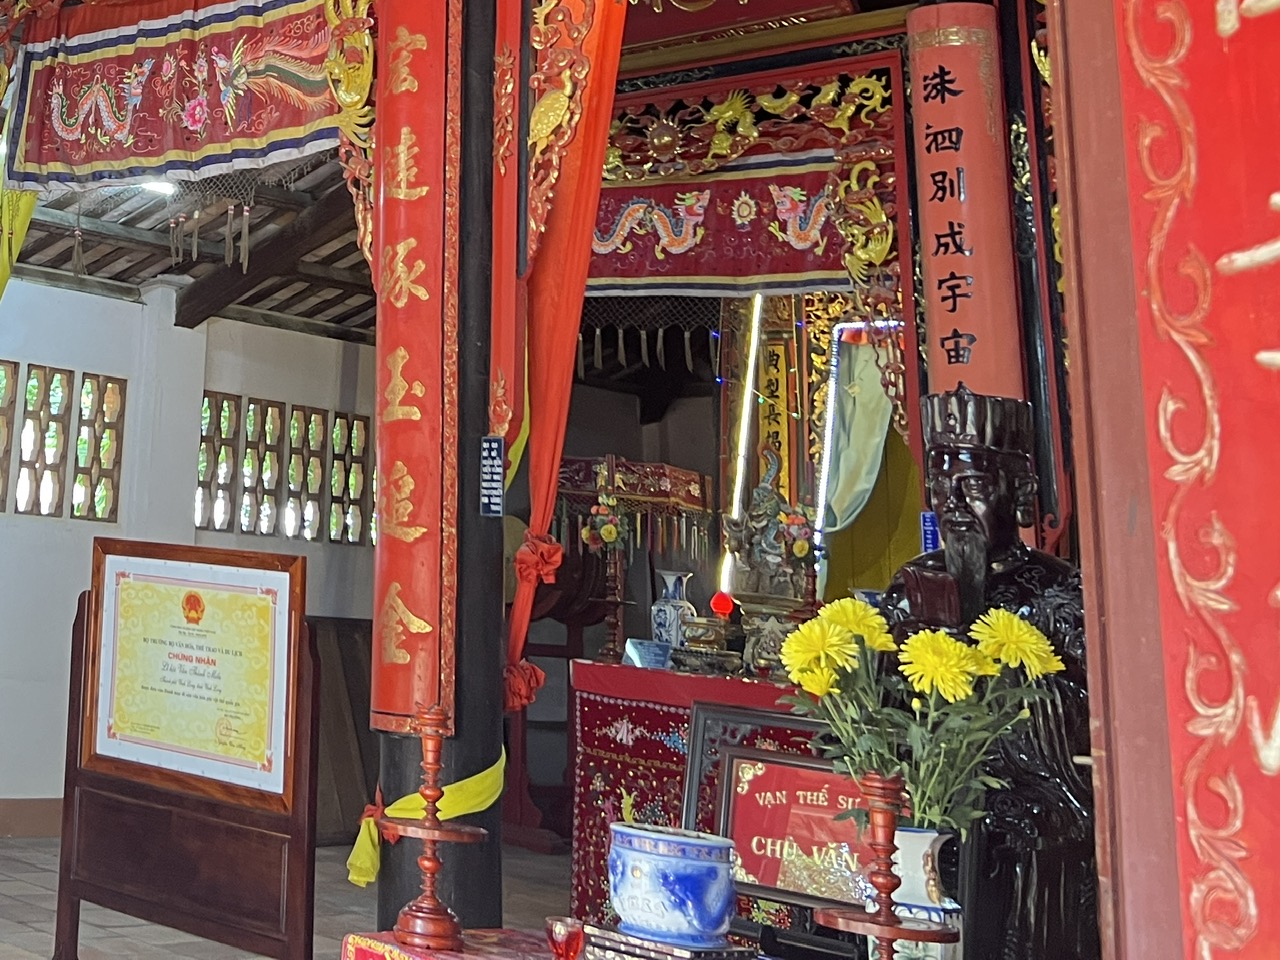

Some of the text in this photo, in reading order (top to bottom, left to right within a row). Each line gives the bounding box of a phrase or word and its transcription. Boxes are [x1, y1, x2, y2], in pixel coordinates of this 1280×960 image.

[922, 65, 978, 397] 洙泗別成宇宙
[755, 791, 787, 808] VẠN
[796, 784, 829, 806] THẾ
[811, 842, 860, 872] VĂN
